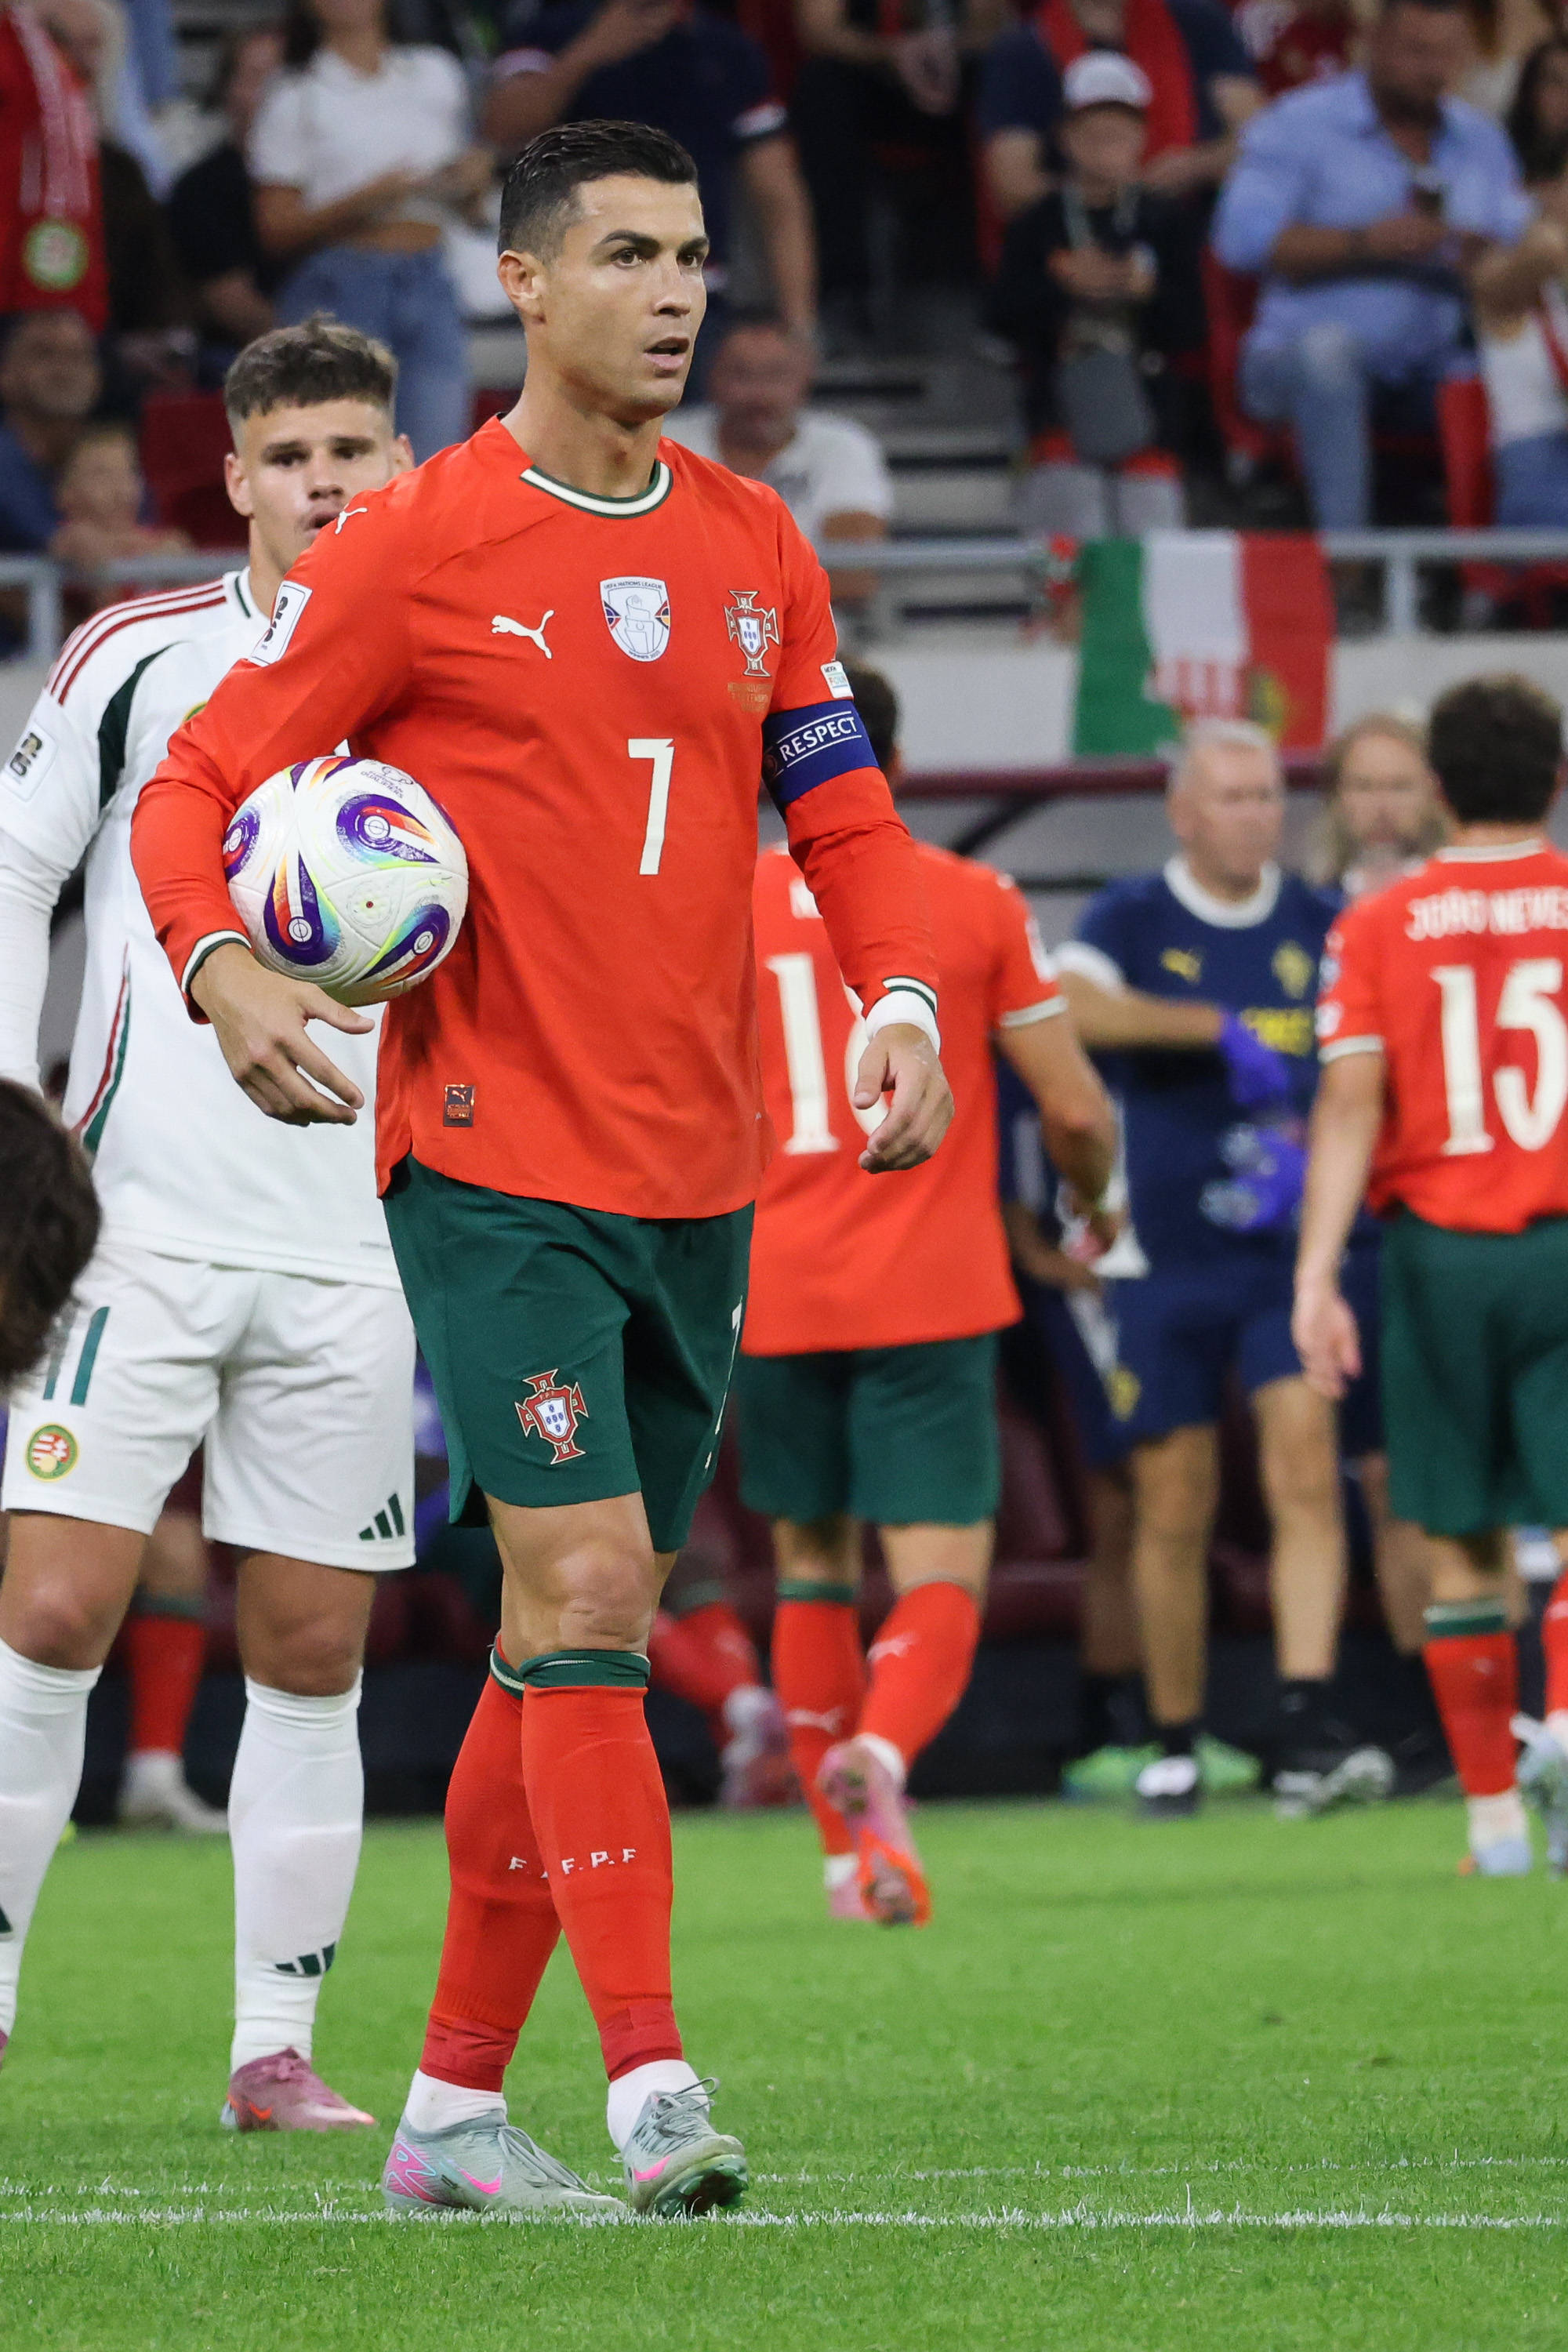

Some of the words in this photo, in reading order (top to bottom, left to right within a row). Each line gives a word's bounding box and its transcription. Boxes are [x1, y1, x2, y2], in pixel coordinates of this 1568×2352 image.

[642, 581, 662, 590] LEAGUE
[779, 717, 857, 761] RESPECT
[627, 738, 674, 875] 7
[1428, 957, 1568, 1157] 15
